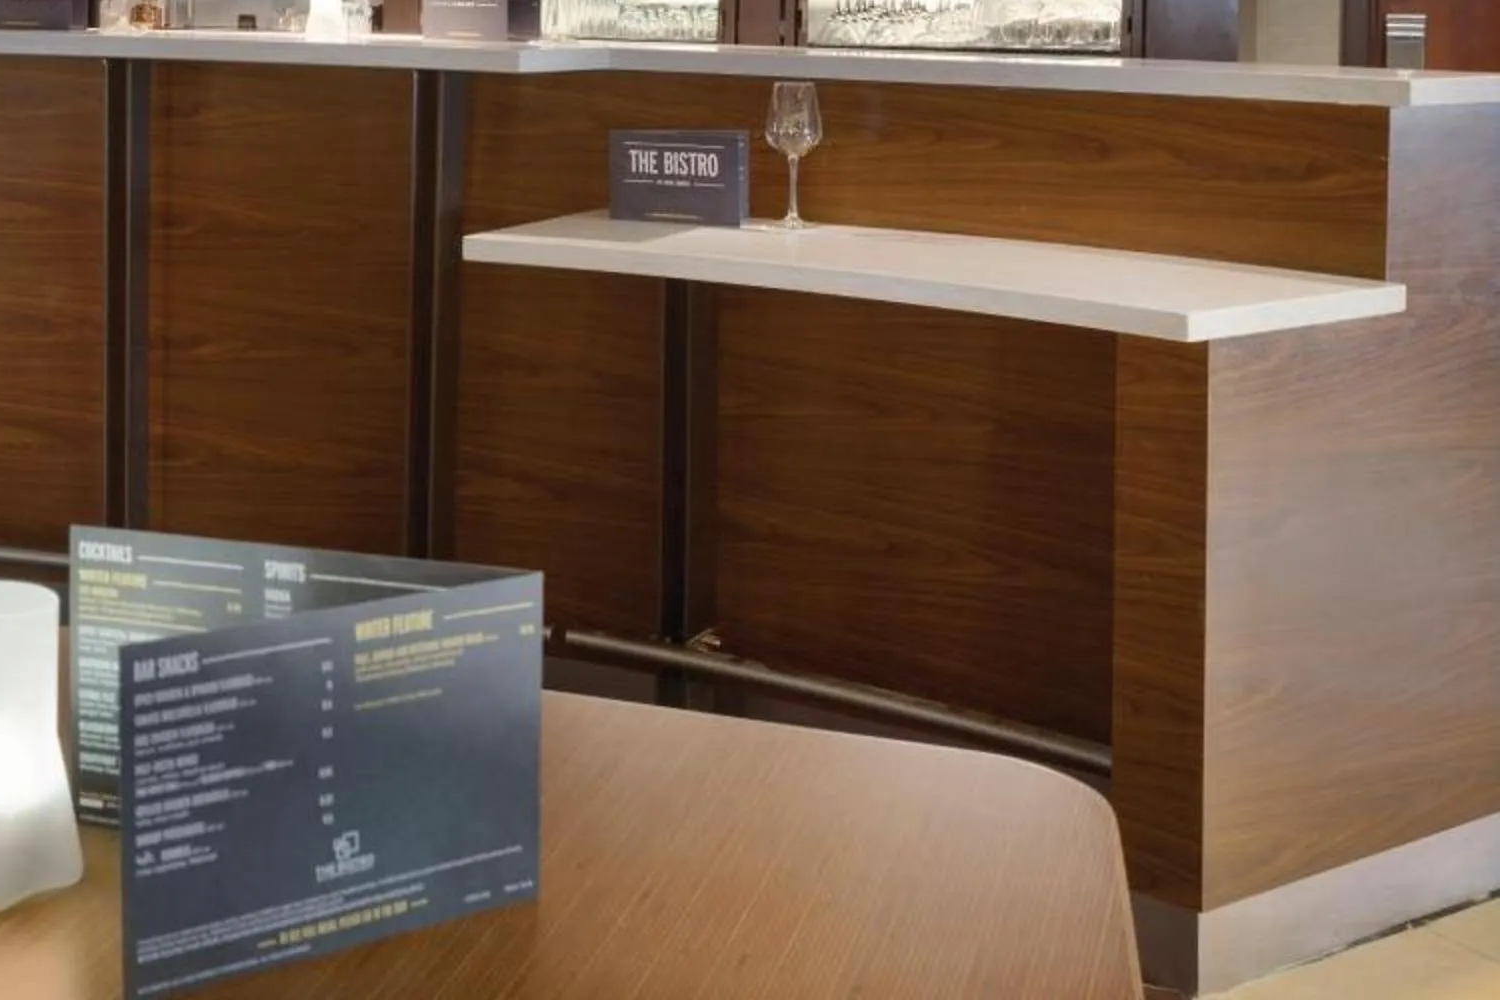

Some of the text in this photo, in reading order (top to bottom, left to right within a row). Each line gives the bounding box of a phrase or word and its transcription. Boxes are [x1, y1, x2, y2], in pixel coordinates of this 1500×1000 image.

[629, 150, 719, 178] THE BISTRO
[78, 541, 133, 564] COCKTAILS
[264, 560, 306, 584] SPIRITS
[133, 650, 198, 683] BAR SNACKS
